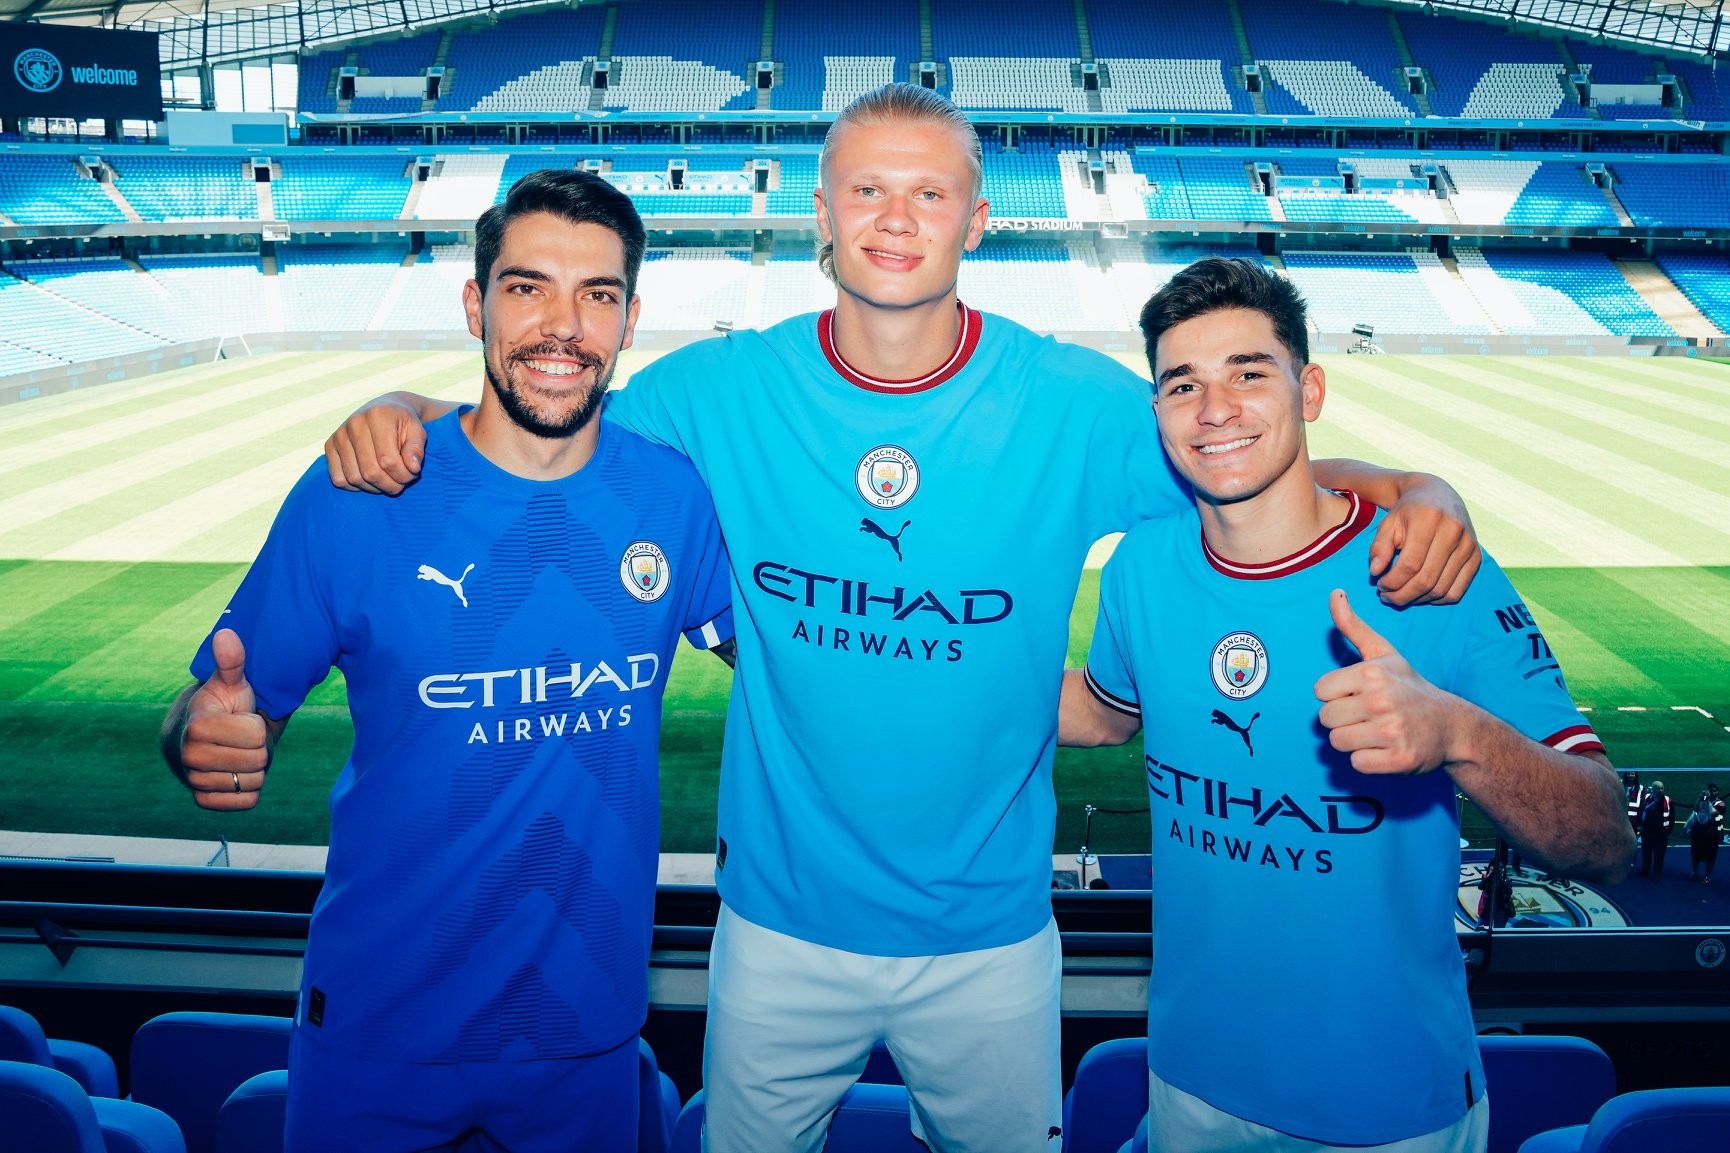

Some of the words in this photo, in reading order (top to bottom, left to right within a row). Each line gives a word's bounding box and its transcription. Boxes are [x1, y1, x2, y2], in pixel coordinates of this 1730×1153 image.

[71, 63, 137, 86] welcome
[1030, 220, 1083, 230] STADIUM
[1683, 229, 1706, 237] welcome
[863, 449, 914, 471] MANCHESTER
[623, 544, 664, 564] MANCHESTER
[753, 561, 1014, 625] ETIHAD
[792, 620, 963, 662] AIRWAYS
[1217, 636, 1265, 660] MANCHESTER
[418, 652, 659, 709] ETIHAD
[1229, 688, 1247, 696] CITY
[468, 705, 632, 744] AIRWAYS
[1145, 754, 1385, 835] ETIHAD
[1170, 818, 1333, 874] AIRWAYS
[1588, 906, 1611, 915] 94
